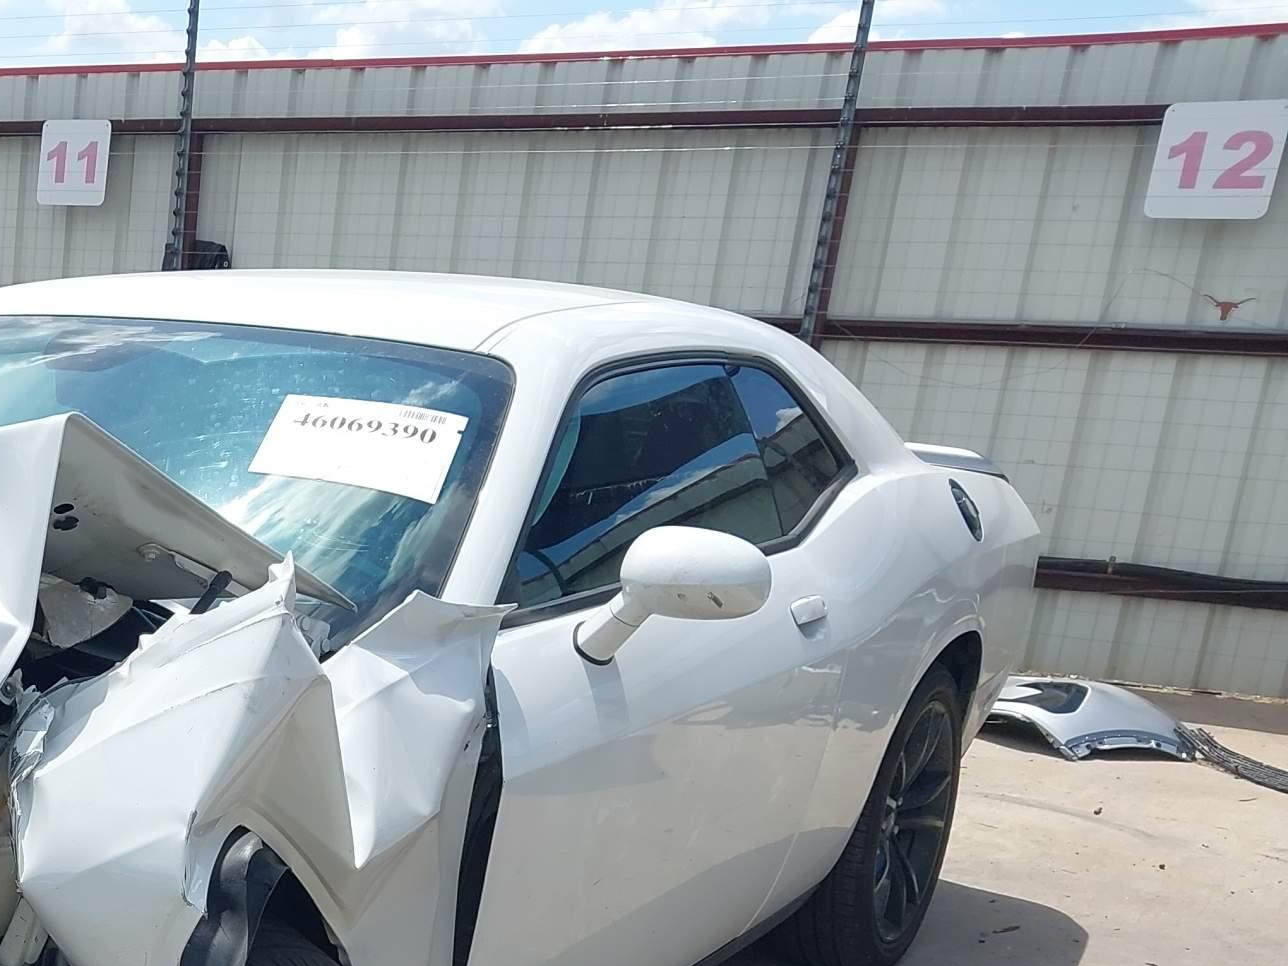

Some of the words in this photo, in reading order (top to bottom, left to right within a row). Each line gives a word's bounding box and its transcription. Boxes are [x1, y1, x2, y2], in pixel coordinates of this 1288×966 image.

[47, 141, 98, 184] 11
[1168, 130, 1274, 189] 12
[293, 413, 437, 444] 46069390
